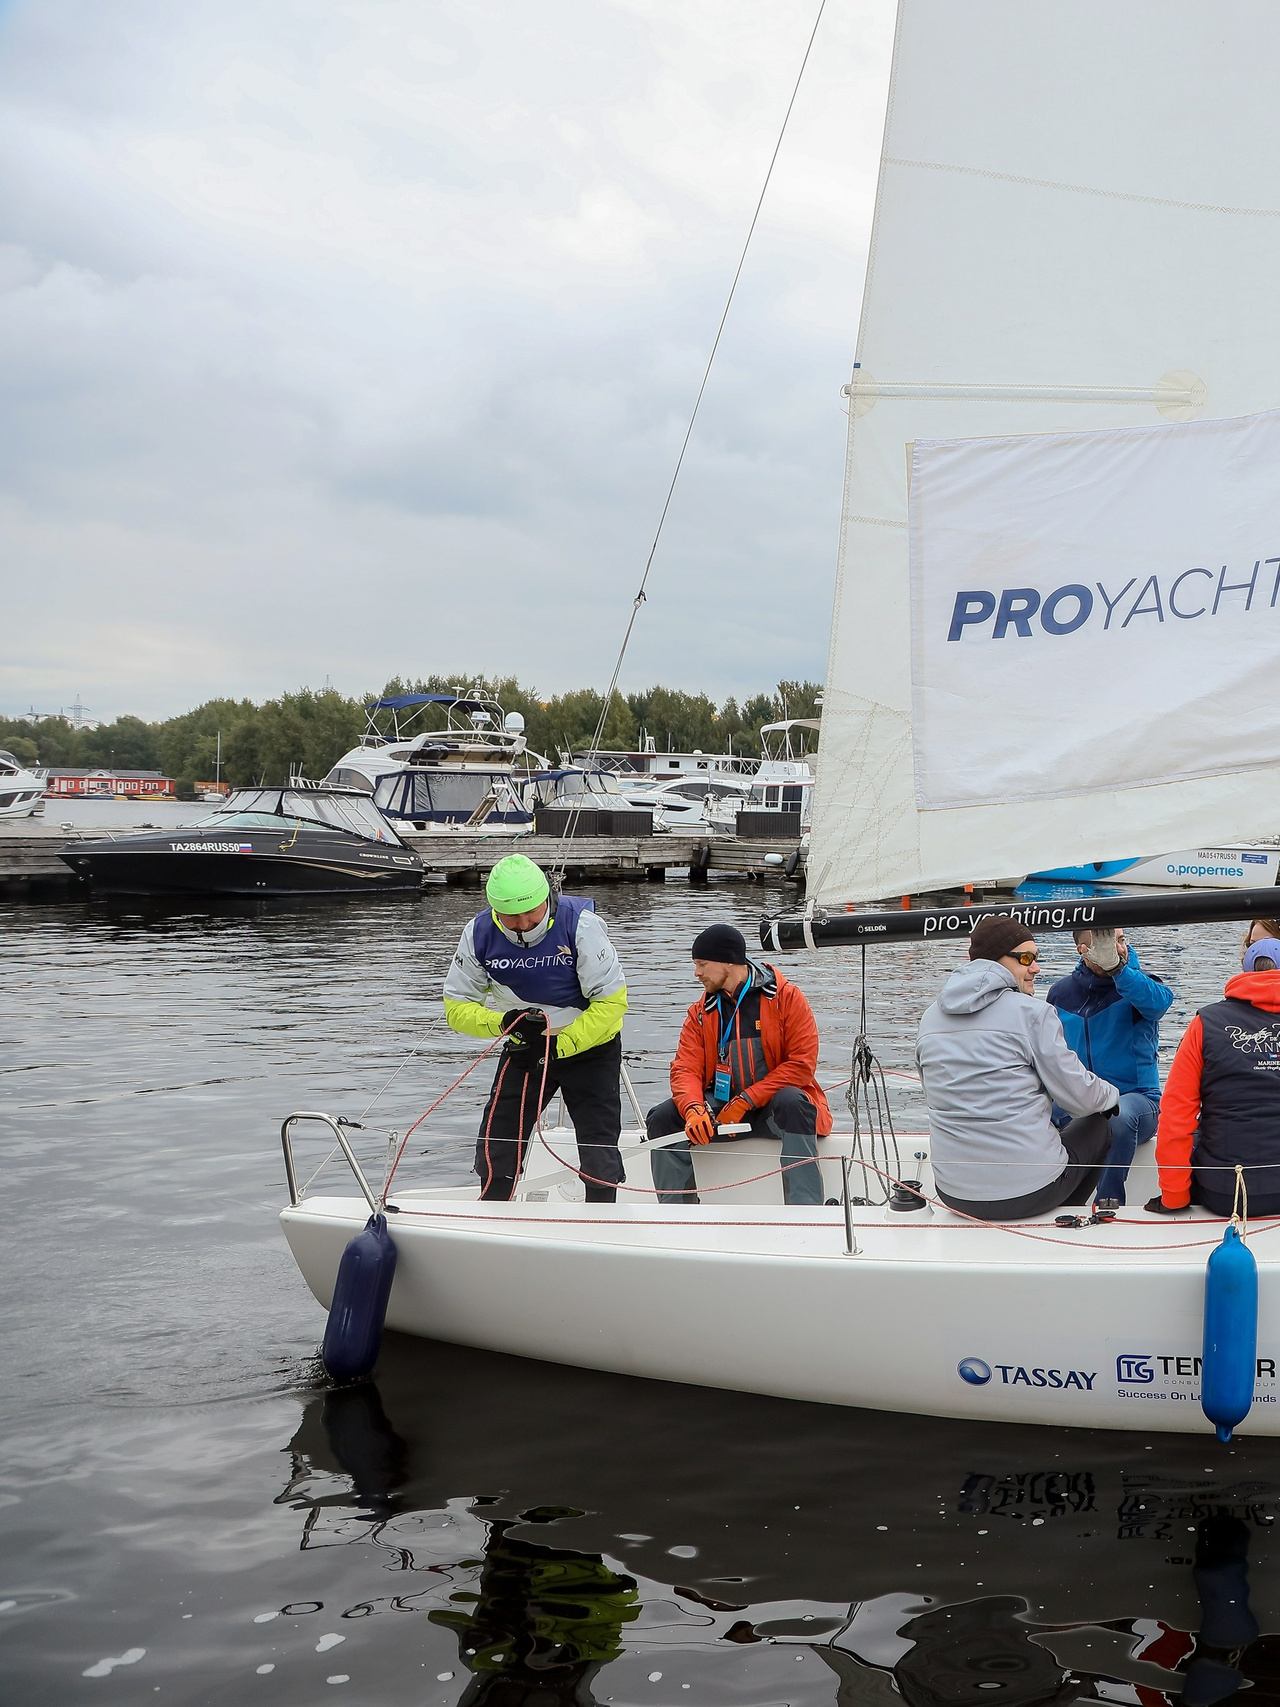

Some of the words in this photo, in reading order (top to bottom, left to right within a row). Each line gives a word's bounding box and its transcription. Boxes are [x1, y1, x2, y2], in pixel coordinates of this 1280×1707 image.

[169, 842, 240, 852] TA2864RUS50
[993, 1363, 1098, 1391] TASSAY
[1117, 1388, 1167, 1400] Success
[1170, 1391, 1187, 1401] On
